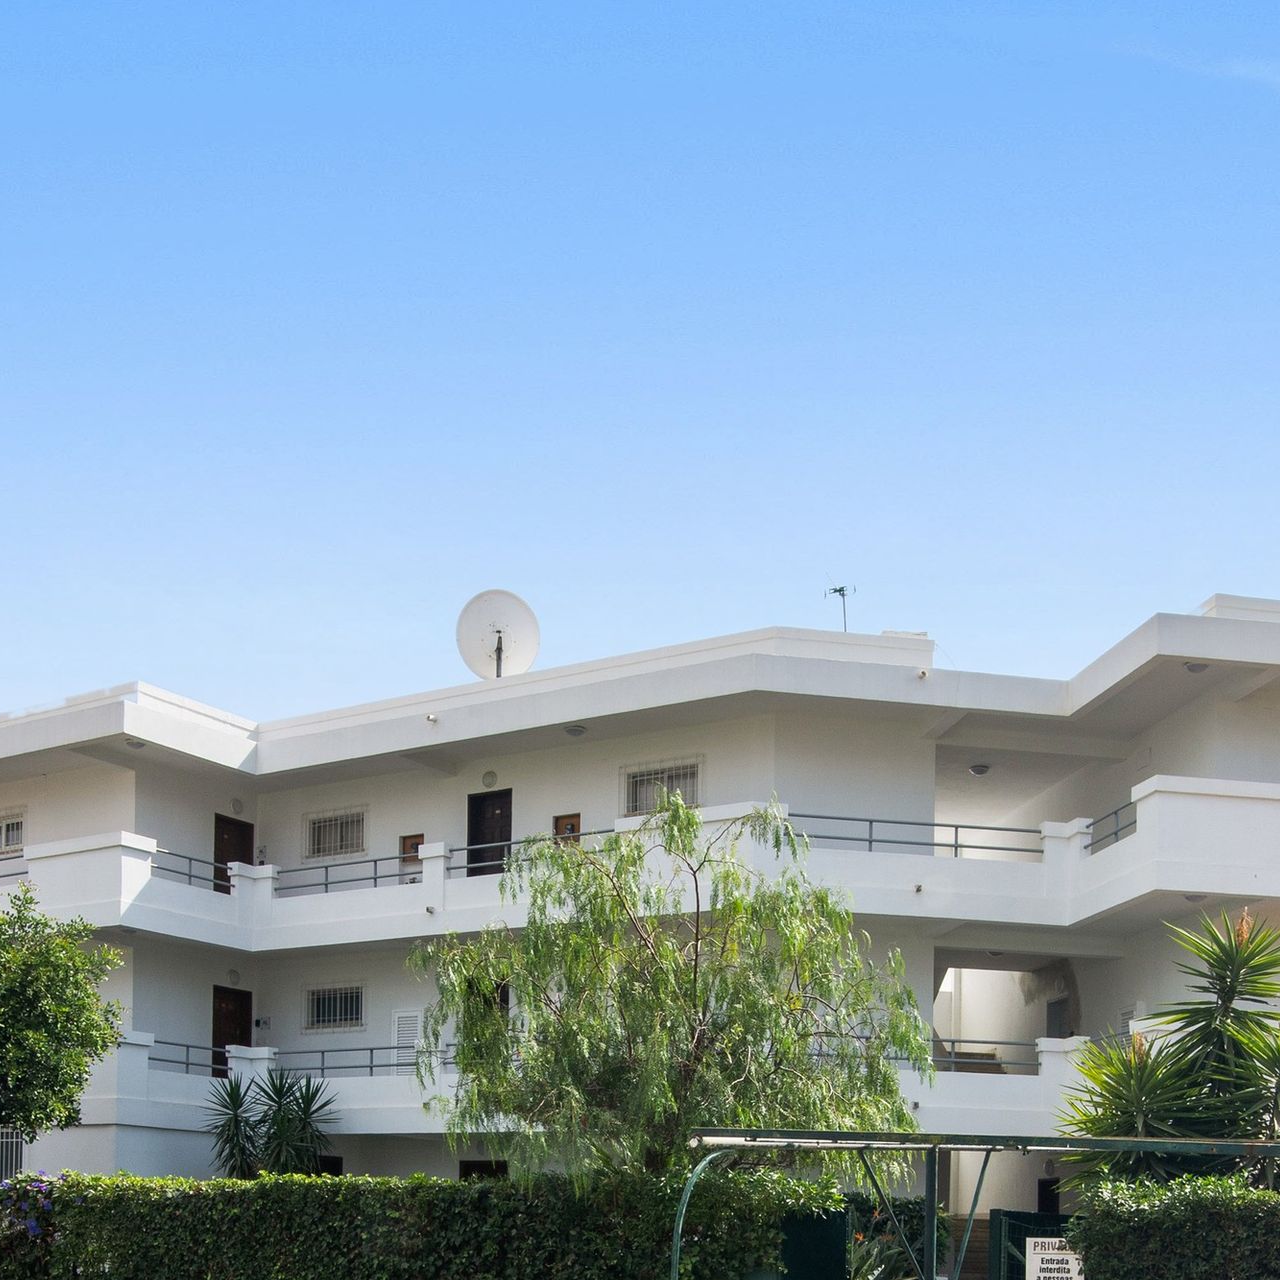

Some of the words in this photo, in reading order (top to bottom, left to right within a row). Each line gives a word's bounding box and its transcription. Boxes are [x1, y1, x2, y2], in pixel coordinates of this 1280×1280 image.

[1033, 1241, 1073, 1251] PRIV
[1040, 1257, 1069, 1265] Entrada
[1039, 1266, 1071, 1274] interdita
